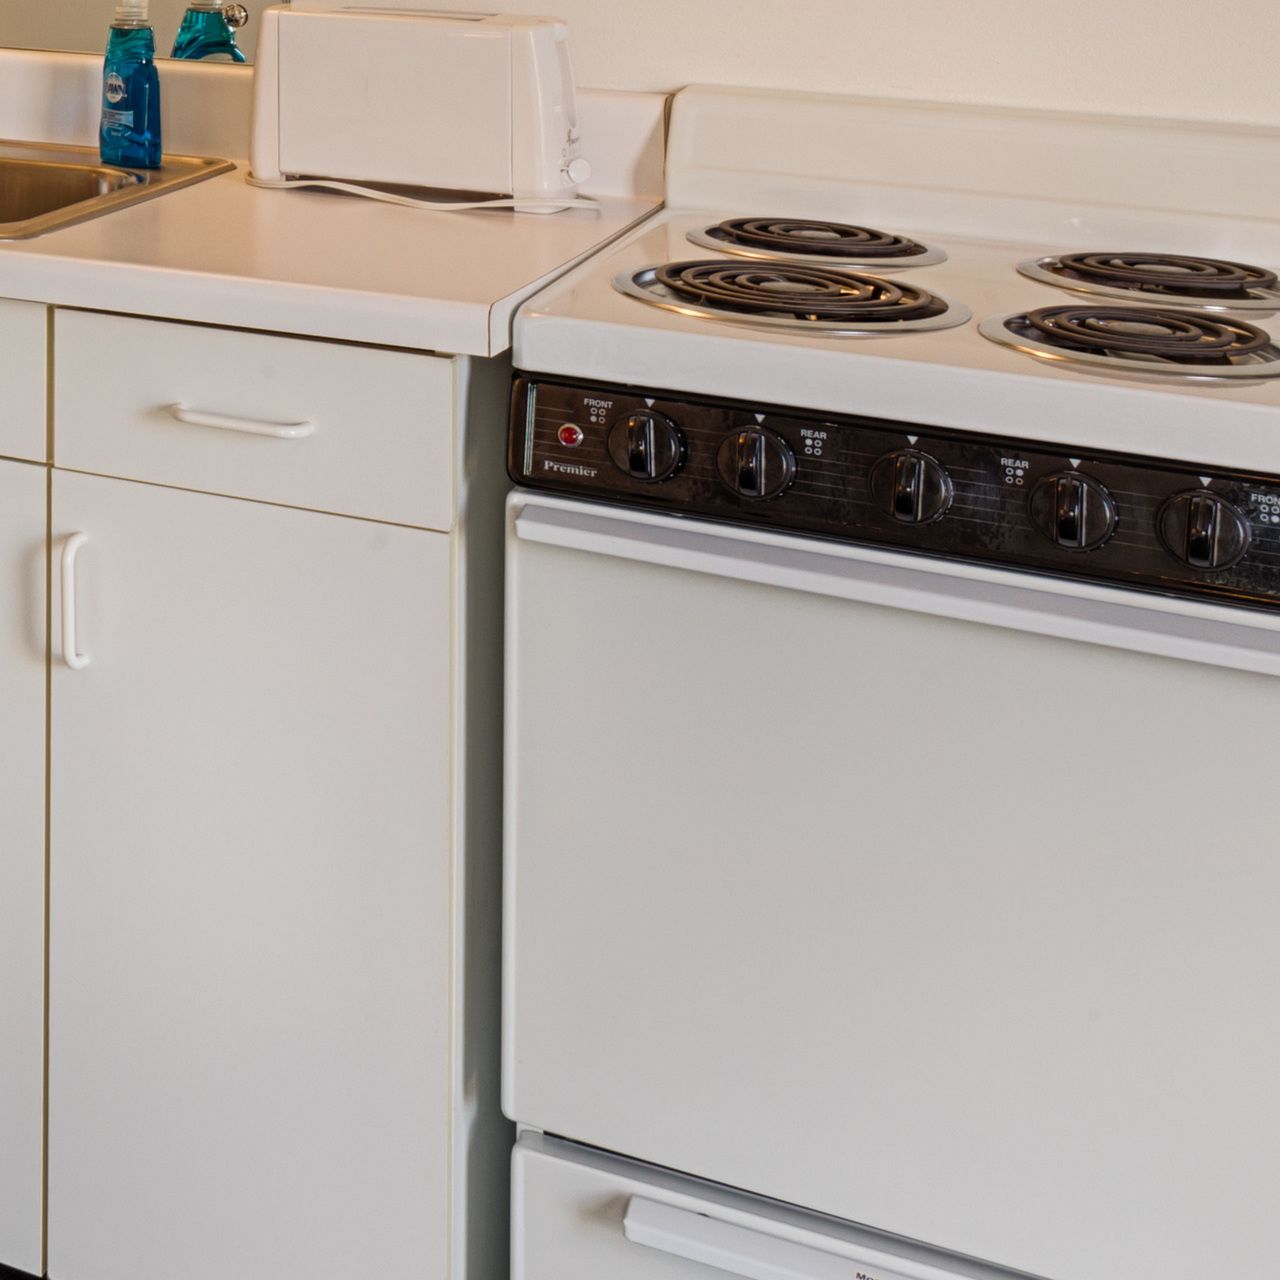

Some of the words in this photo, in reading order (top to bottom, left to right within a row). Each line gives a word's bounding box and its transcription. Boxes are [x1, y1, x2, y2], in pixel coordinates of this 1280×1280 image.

[583, 397, 613, 409] FRONT
[800, 429, 827, 440] REAR
[543, 459, 598, 478] Premier
[1000, 457, 1029, 469] REAR
[1251, 493, 1280, 506] FRON
